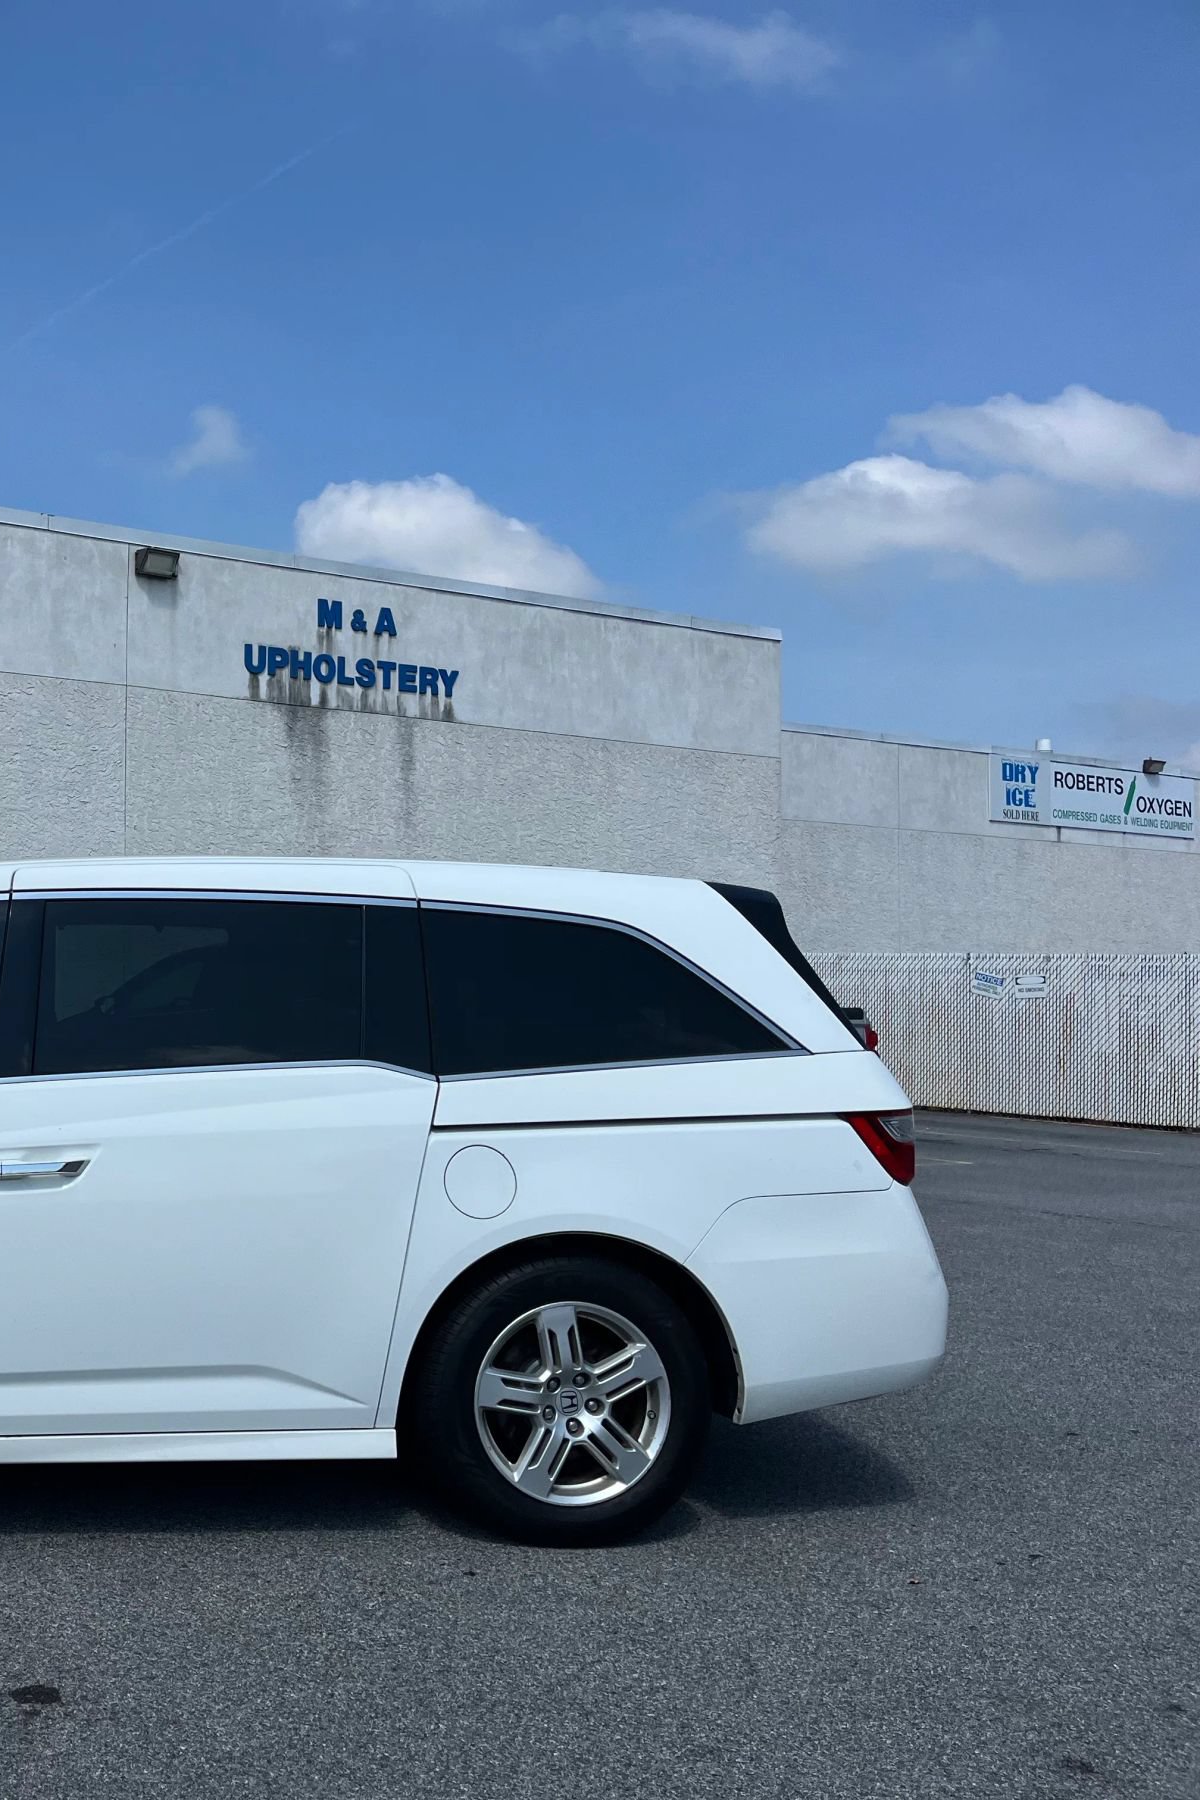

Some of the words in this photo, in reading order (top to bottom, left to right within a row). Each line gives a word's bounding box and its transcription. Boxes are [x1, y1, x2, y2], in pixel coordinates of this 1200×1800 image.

[317, 598, 342, 629] M
[350, 609, 367, 632] &
[374, 607, 397, 636] A
[244, 643, 460, 698] UPHOLSTERY
[1001, 759, 1039, 784] DRY
[1006, 784, 1036, 808] ICE
[1054, 771, 1124, 795] ROBERTS
[1136, 796, 1192, 818] OXYGEN
[1002, 808, 1021, 820] SOLD
[1021, 810, 1040, 822] HERE
[1052, 808, 1098, 823] COMPRESSED
[1100, 814, 1122, 825] GASES
[1131, 816, 1159, 829] WELDING
[1160, 820, 1194, 831] EQUIPMENT
[975, 973, 1003, 986] NOTICE
